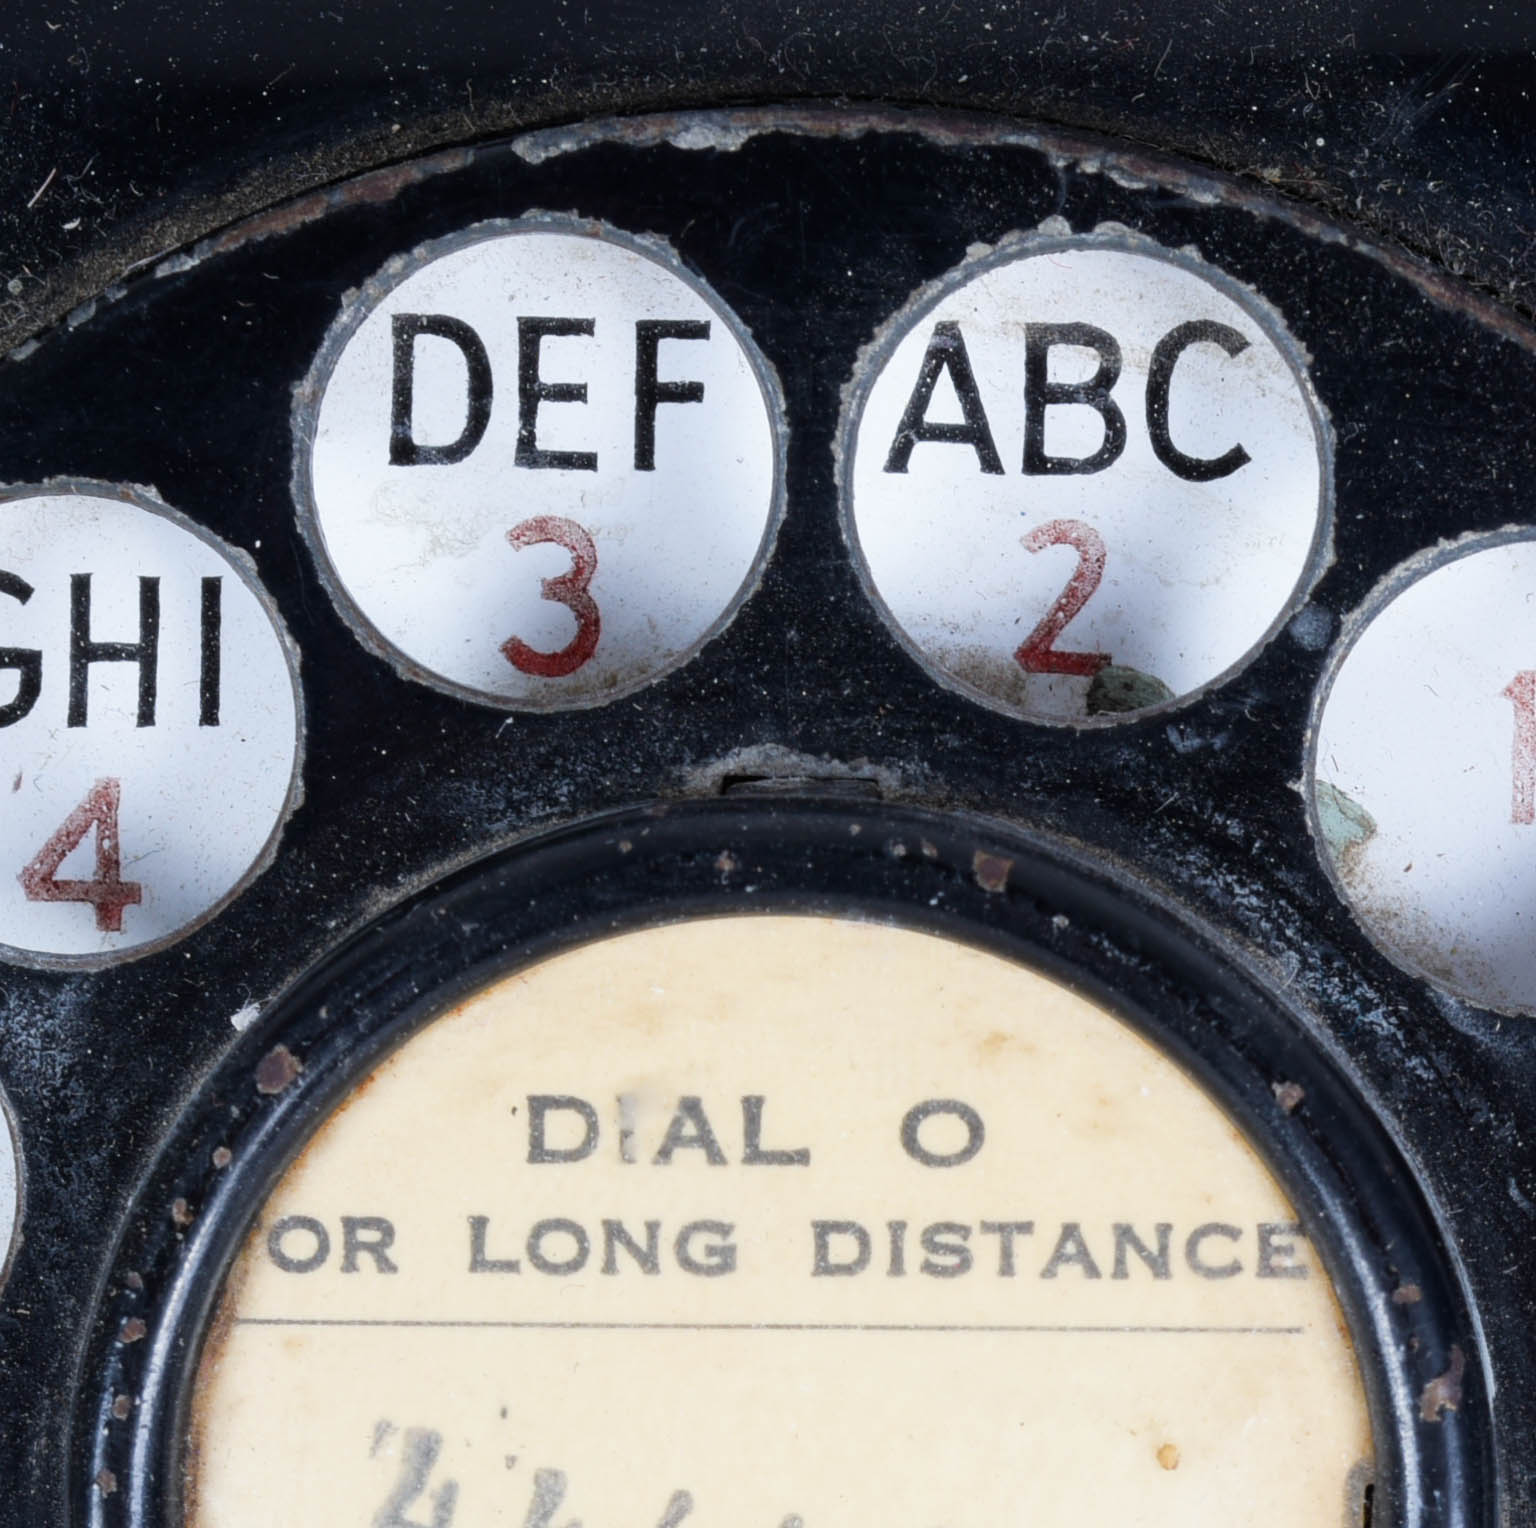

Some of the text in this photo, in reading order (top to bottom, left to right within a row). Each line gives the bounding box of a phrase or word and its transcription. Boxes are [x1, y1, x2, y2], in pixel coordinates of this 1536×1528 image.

[388, 313, 711, 472] DEF
[883, 319, 1253, 483] ABC
[498, 515, 601, 678] 3
[1012, 519, 1113, 675] 2
[1500, 669, 1536, 825] 1
[17, 777, 143, 932] 4
[526, 1094, 811, 1167] DIAL
[467, 1215, 738, 1277] LONG
[810, 1219, 1310, 1282] DISTANCE
